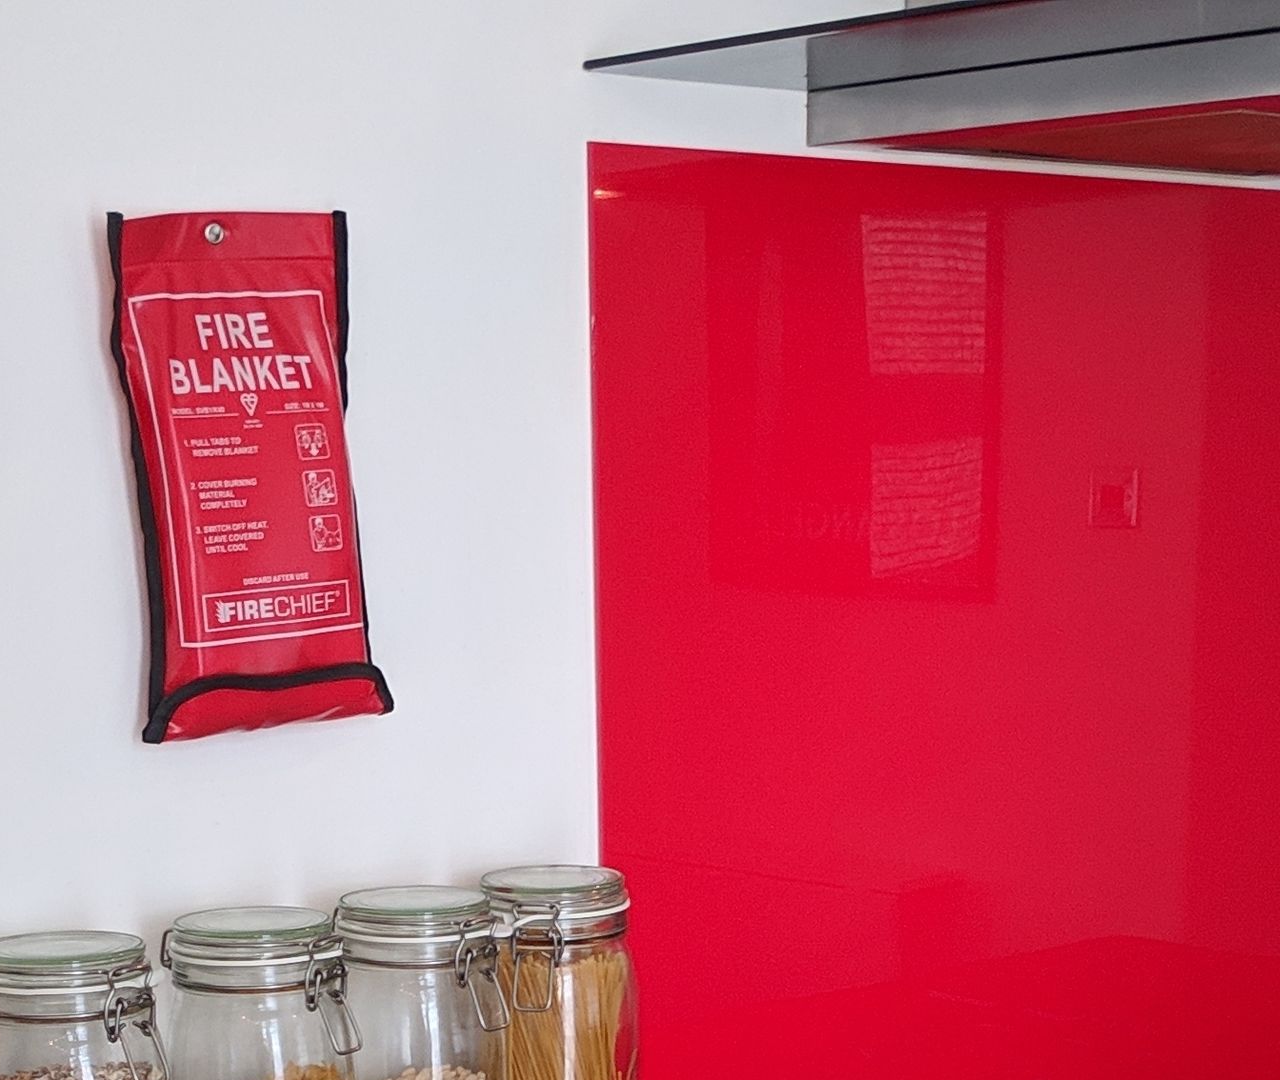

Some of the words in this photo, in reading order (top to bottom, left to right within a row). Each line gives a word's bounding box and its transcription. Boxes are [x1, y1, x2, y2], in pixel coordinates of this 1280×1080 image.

[195, 312, 274, 350] FIRE
[169, 355, 312, 394] BLANKET
[190, 439, 210, 447] PULL
[210, 437, 230, 445] TABS
[230, 436, 241, 445] TO
[192, 448, 224, 457] REMOVE
[224, 446, 258, 456] BLANKET
[198, 480, 223, 489] COVER
[223, 478, 257, 487] BURNING
[199, 490, 235, 499] MATERIAL
[201, 499, 247, 510] COMPLETELY
[203, 524, 231, 533] SWITCH
[231, 522, 246, 531] OFF
[204, 535, 228, 544] LEAVE
[228, 532, 264, 542] COVERED
[205, 545, 227, 554] UNTIL
[227, 543, 248, 552] COOL
[243, 576, 271, 586] DISCARD
[271, 573, 294, 583] AFTER
[295, 572, 309, 580] USE
[216, 590, 336, 624] FIRECHIEF
